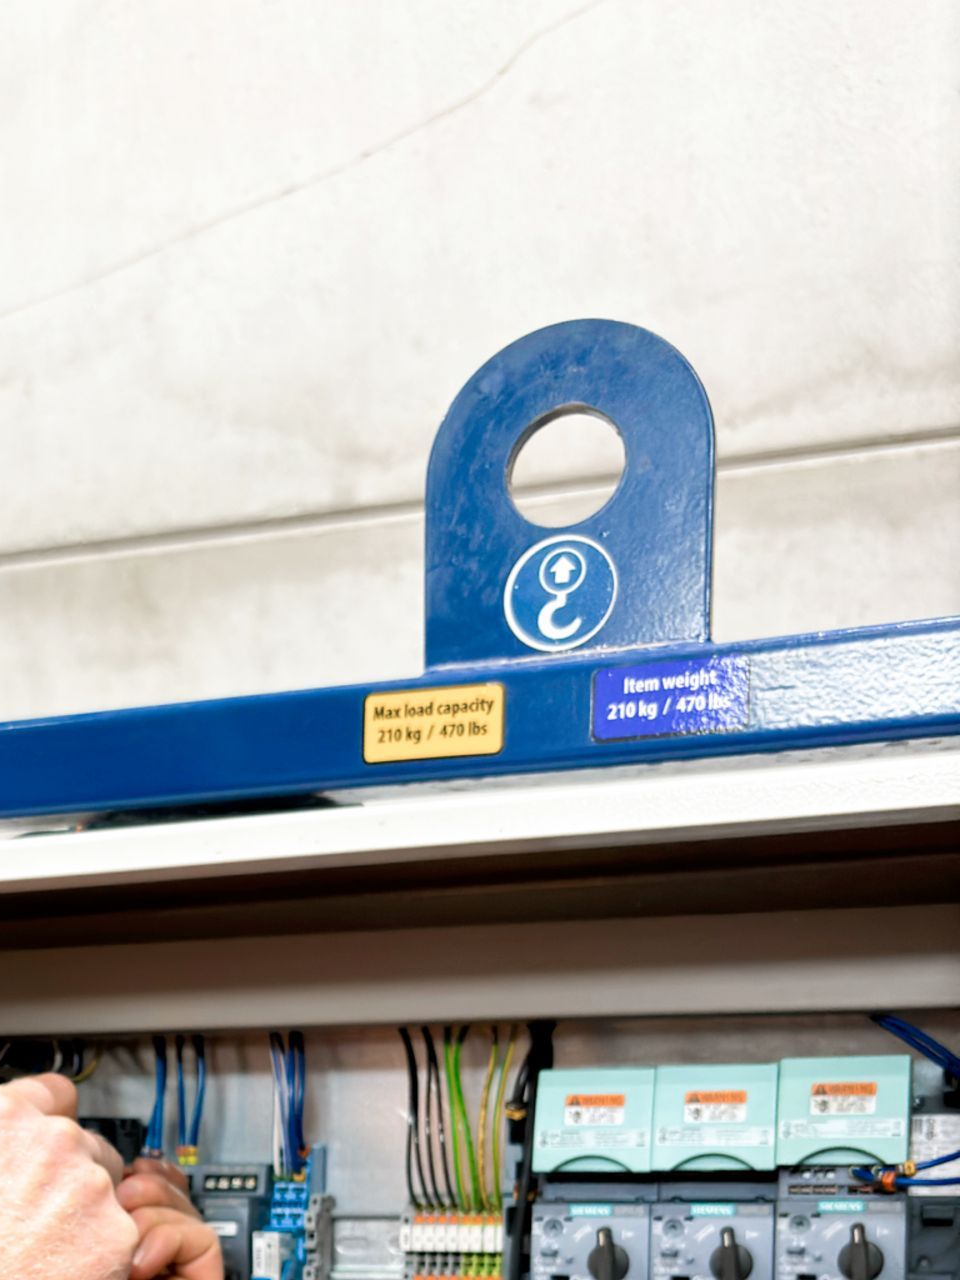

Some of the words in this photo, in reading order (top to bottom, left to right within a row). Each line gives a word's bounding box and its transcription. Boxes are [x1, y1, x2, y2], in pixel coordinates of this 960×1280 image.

[624, 677, 659, 694] Item
[662, 668, 717, 691] weight
[373, 706, 400, 720] Max
[404, 702, 434, 718] load
[437, 698, 494, 717] capacity
[607, 701, 636, 720] 210
[638, 700, 658, 720] kg
[662, 697, 672, 715] /
[676, 695, 706, 713] 470
[708, 692, 731, 710] lbs
[377, 728, 402, 743] 210
[405, 727, 421, 744] kg
[427, 724, 435, 740] /
[440, 723, 465, 738] 470
[468, 721, 487, 736] lbs
